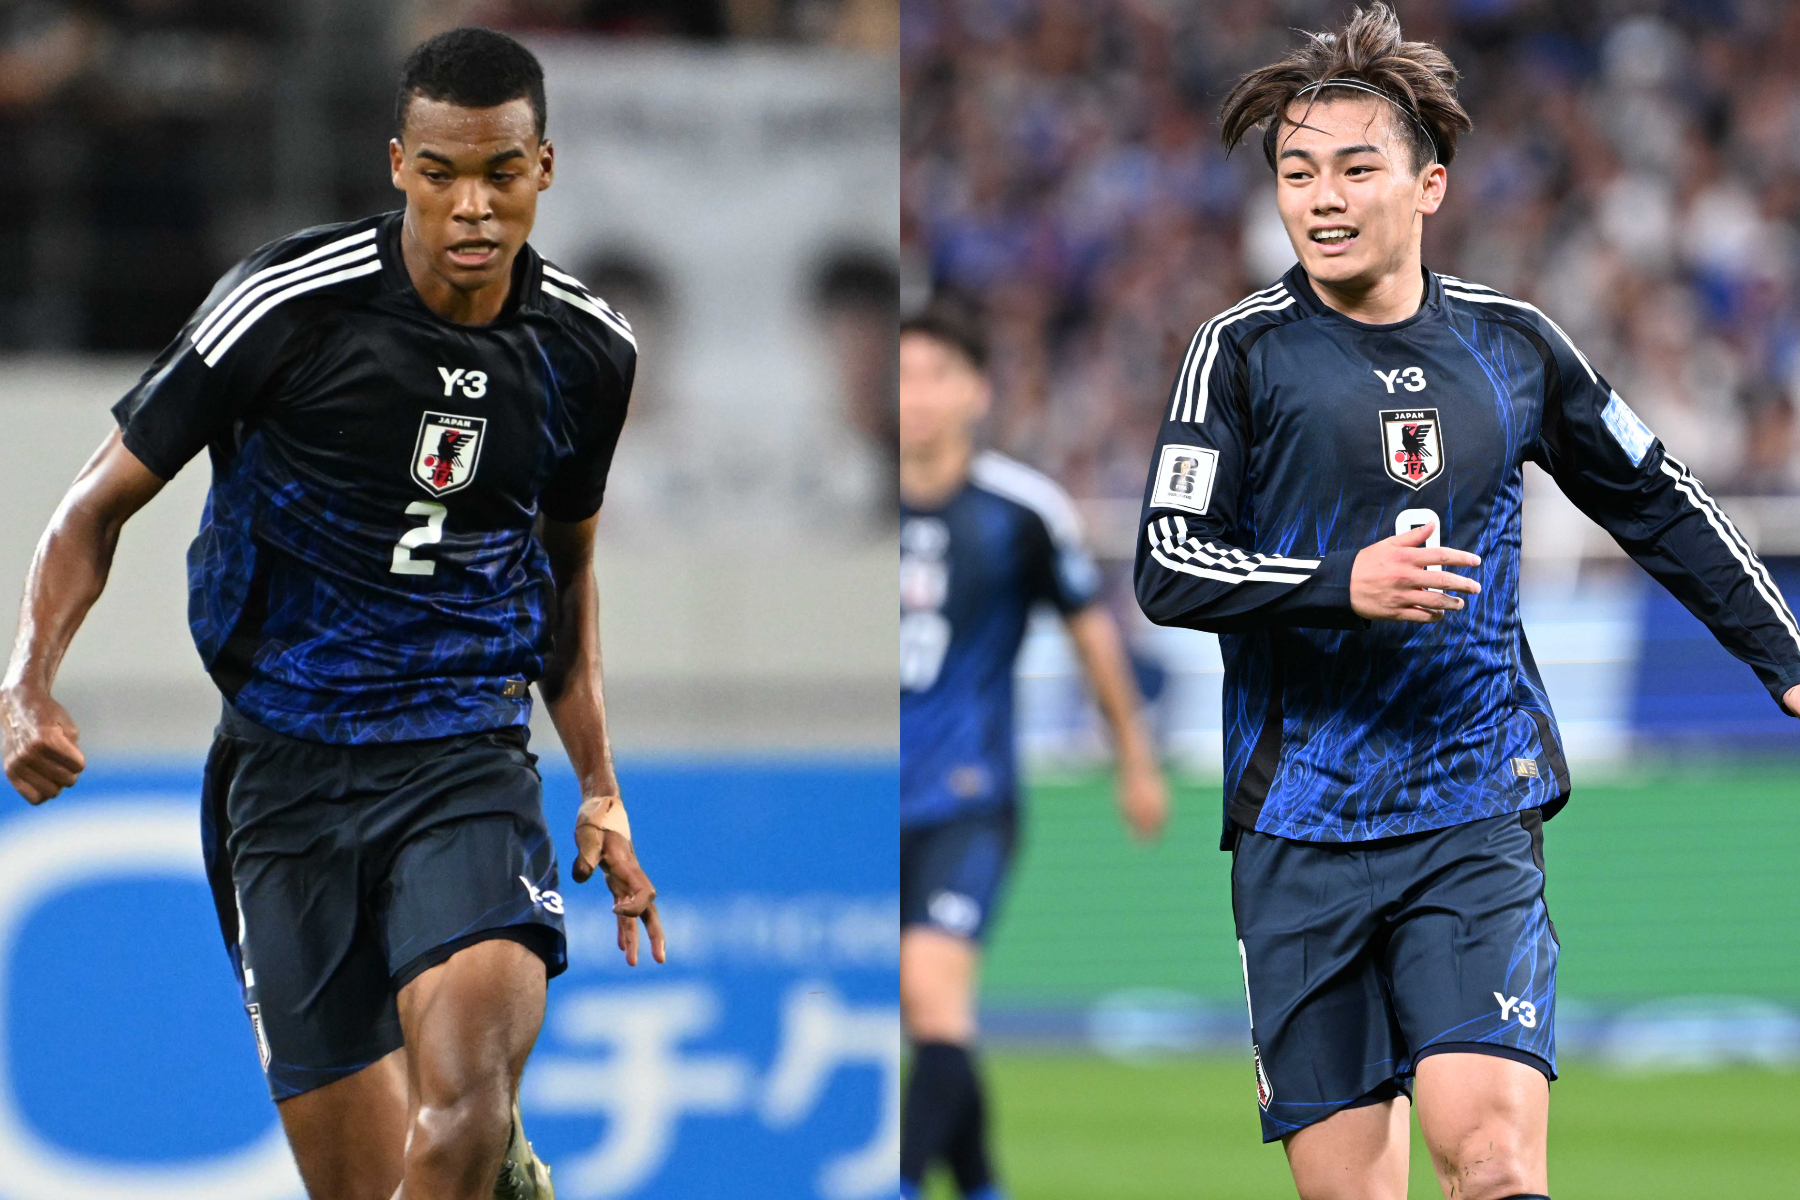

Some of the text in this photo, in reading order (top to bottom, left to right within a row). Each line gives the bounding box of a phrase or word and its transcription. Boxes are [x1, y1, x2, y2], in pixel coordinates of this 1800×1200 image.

[437, 366, 488, 399] Y-3
[1373, 366, 1427, 394] Y-3
[438, 417, 471, 428] JAPAN
[1395, 412, 1424, 420] JAPAN
[427, 468, 455, 484] JFA
[1401, 462, 1429, 476] JFA
[389, 500, 448, 576] 2
[1493, 991, 1537, 1028] Y-3
